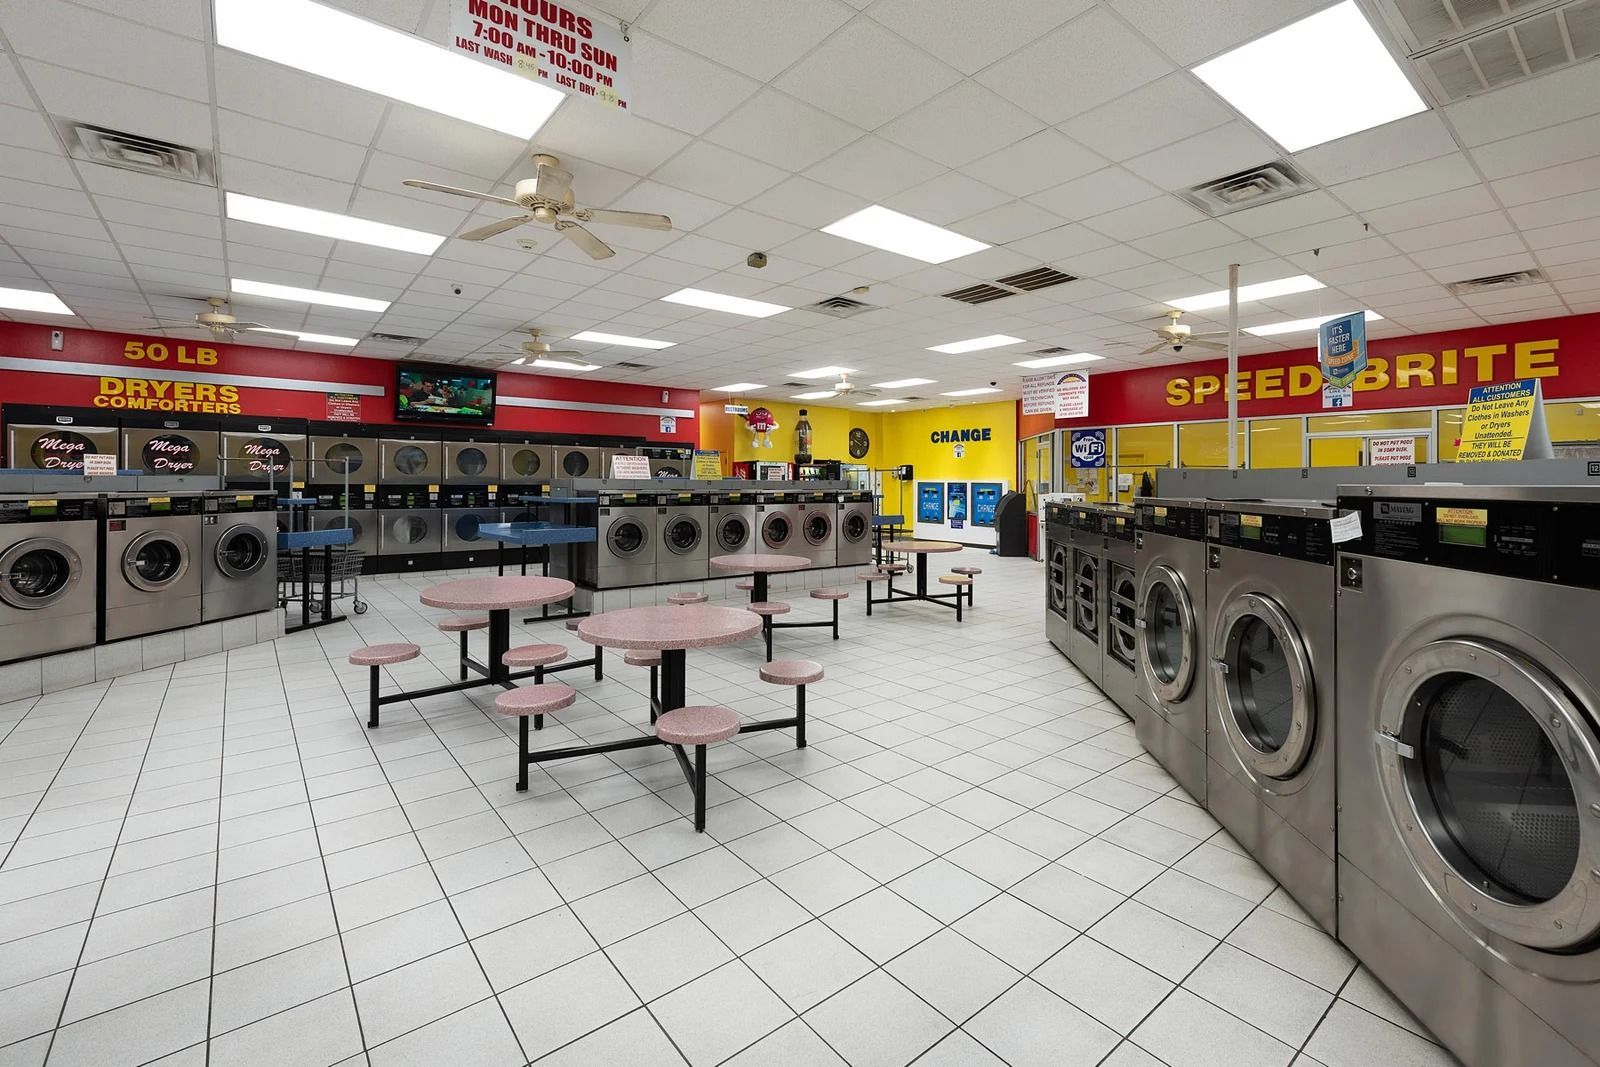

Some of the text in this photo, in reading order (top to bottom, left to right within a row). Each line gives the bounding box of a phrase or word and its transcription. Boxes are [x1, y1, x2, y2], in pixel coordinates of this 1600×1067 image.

[469, 0, 617, 72] MON THRU SUN
[472, 20, 514, 49] 7:00
[516, 42, 536, 58] AM
[596, 72, 612, 88] PM
[456, 36, 480, 54] LAST
[484, 46, 513, 66] WASH
[538, 68, 548, 78] PM
[556, 73, 578, 90] LAST
[618, 98, 627, 109] PM
[1331, 325, 1343, 335] IT'S
[1328, 332, 1350, 344] FASTER
[124, 341, 218, 366] 50 LB
[1331, 344, 1346, 353] HERE
[1166, 340, 1560, 407] SPEED BRITE
[100, 376, 240, 403] DRYERS
[1482, 382, 1522, 394] ATTENTION
[1486, 389, 1530, 401] CUSTOMERS
[93, 395, 241, 415] COMFORTERS
[1495, 401, 1514, 410] Leave
[1515, 399, 1529, 408] Any
[1467, 413, 1491, 422] Clothes
[1501, 409, 1529, 418] Washers
[1489, 421, 1511, 430] Dryers
[930, 428, 991, 443] CHANGE
[1474, 430, 1513, 439] Unattended.
[38, 438, 85, 454] Mega
[149, 440, 190, 453] Mega
[244, 444, 280, 457] Mega
[1472, 442, 1486, 450] THEY
[44, 457, 84, 470] Drye
[154, 458, 193, 469] Dryer
[249, 460, 284, 473] Dryer
[923, 502, 939, 511] CHANGE
